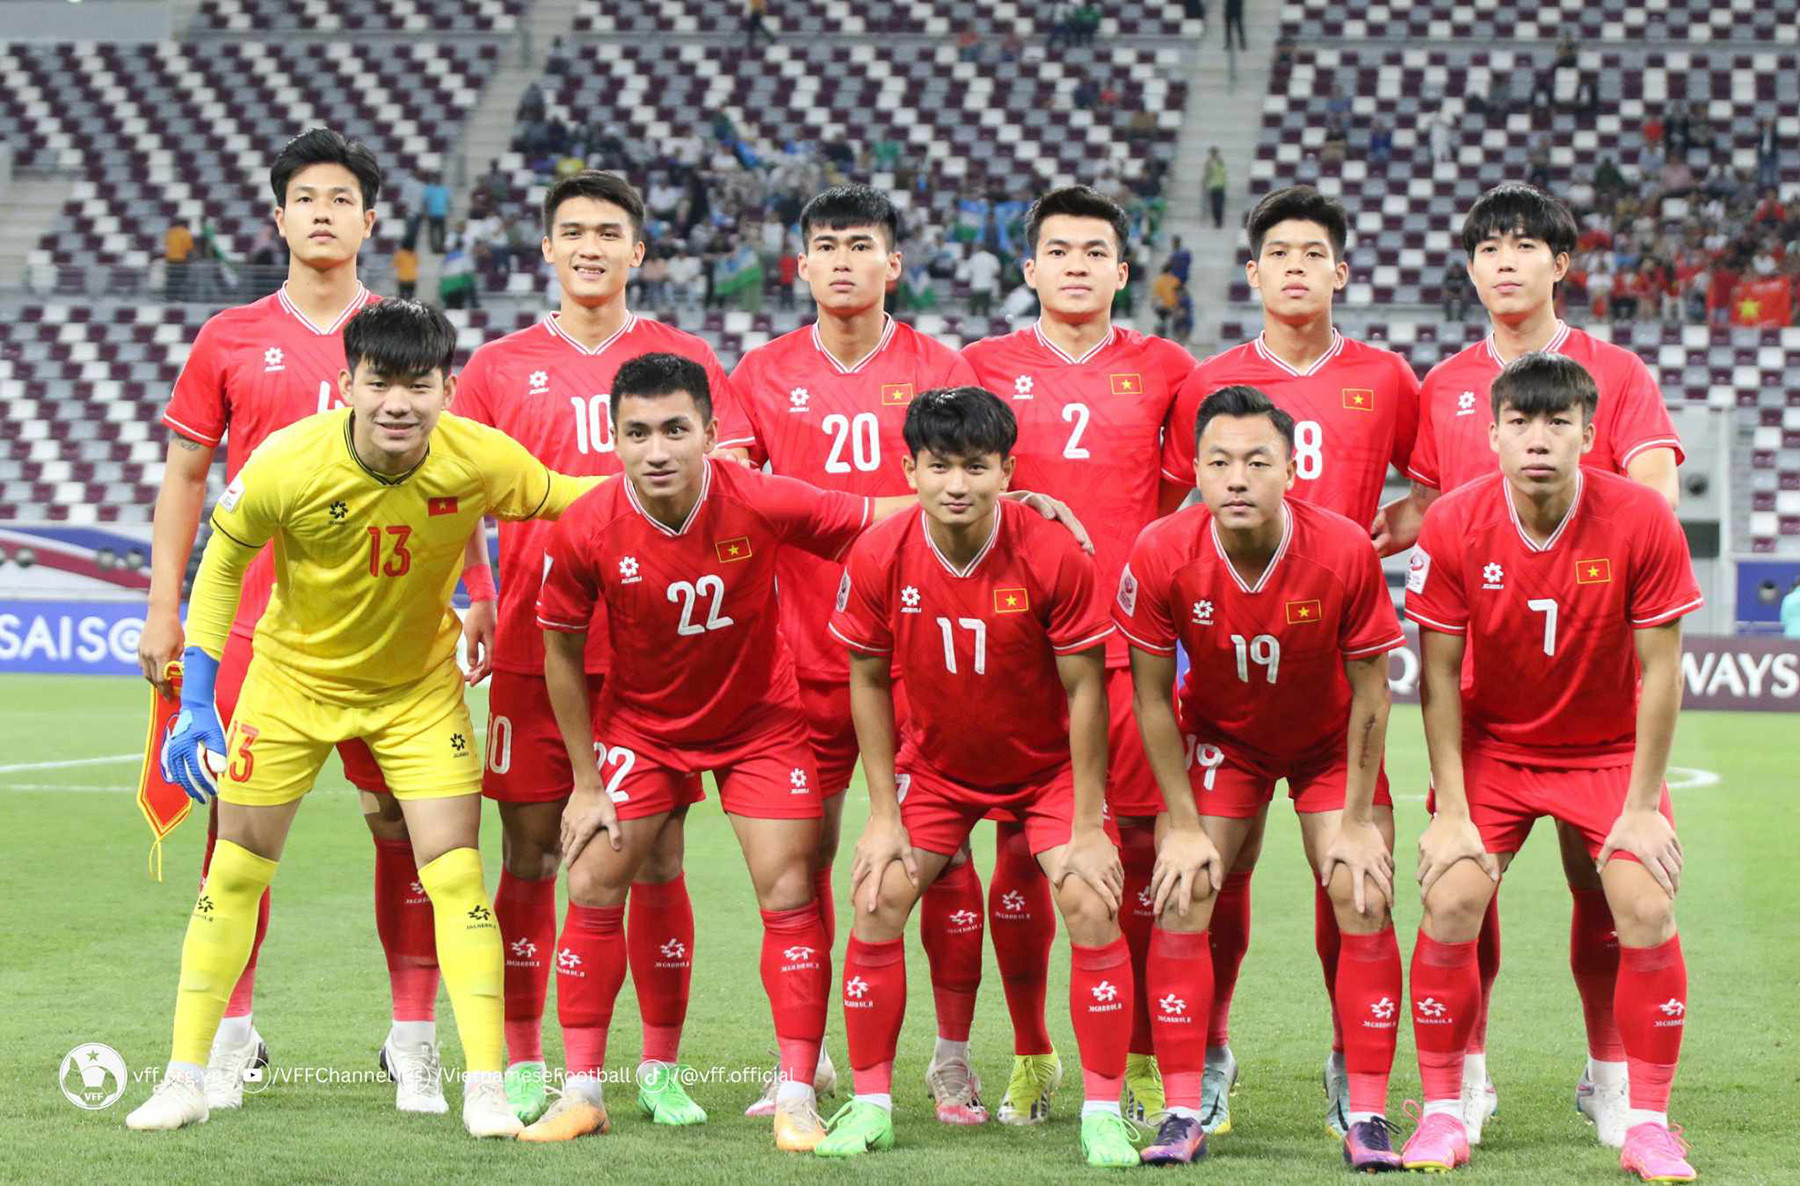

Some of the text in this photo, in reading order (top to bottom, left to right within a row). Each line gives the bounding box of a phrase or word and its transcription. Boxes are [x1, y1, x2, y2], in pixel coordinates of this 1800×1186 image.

[570, 394, 614, 454] 10
[822, 412, 881, 473] 20
[1062, 403, 1090, 459] 2
[1294, 420, 1322, 480] 8
[367, 525, 412, 577] 13
[667, 574, 734, 636] 22
[1527, 598, 1558, 657] 7
[0, 613, 187, 664] SAISO
[936, 617, 987, 675] 17
[1231, 634, 1280, 684] 19
